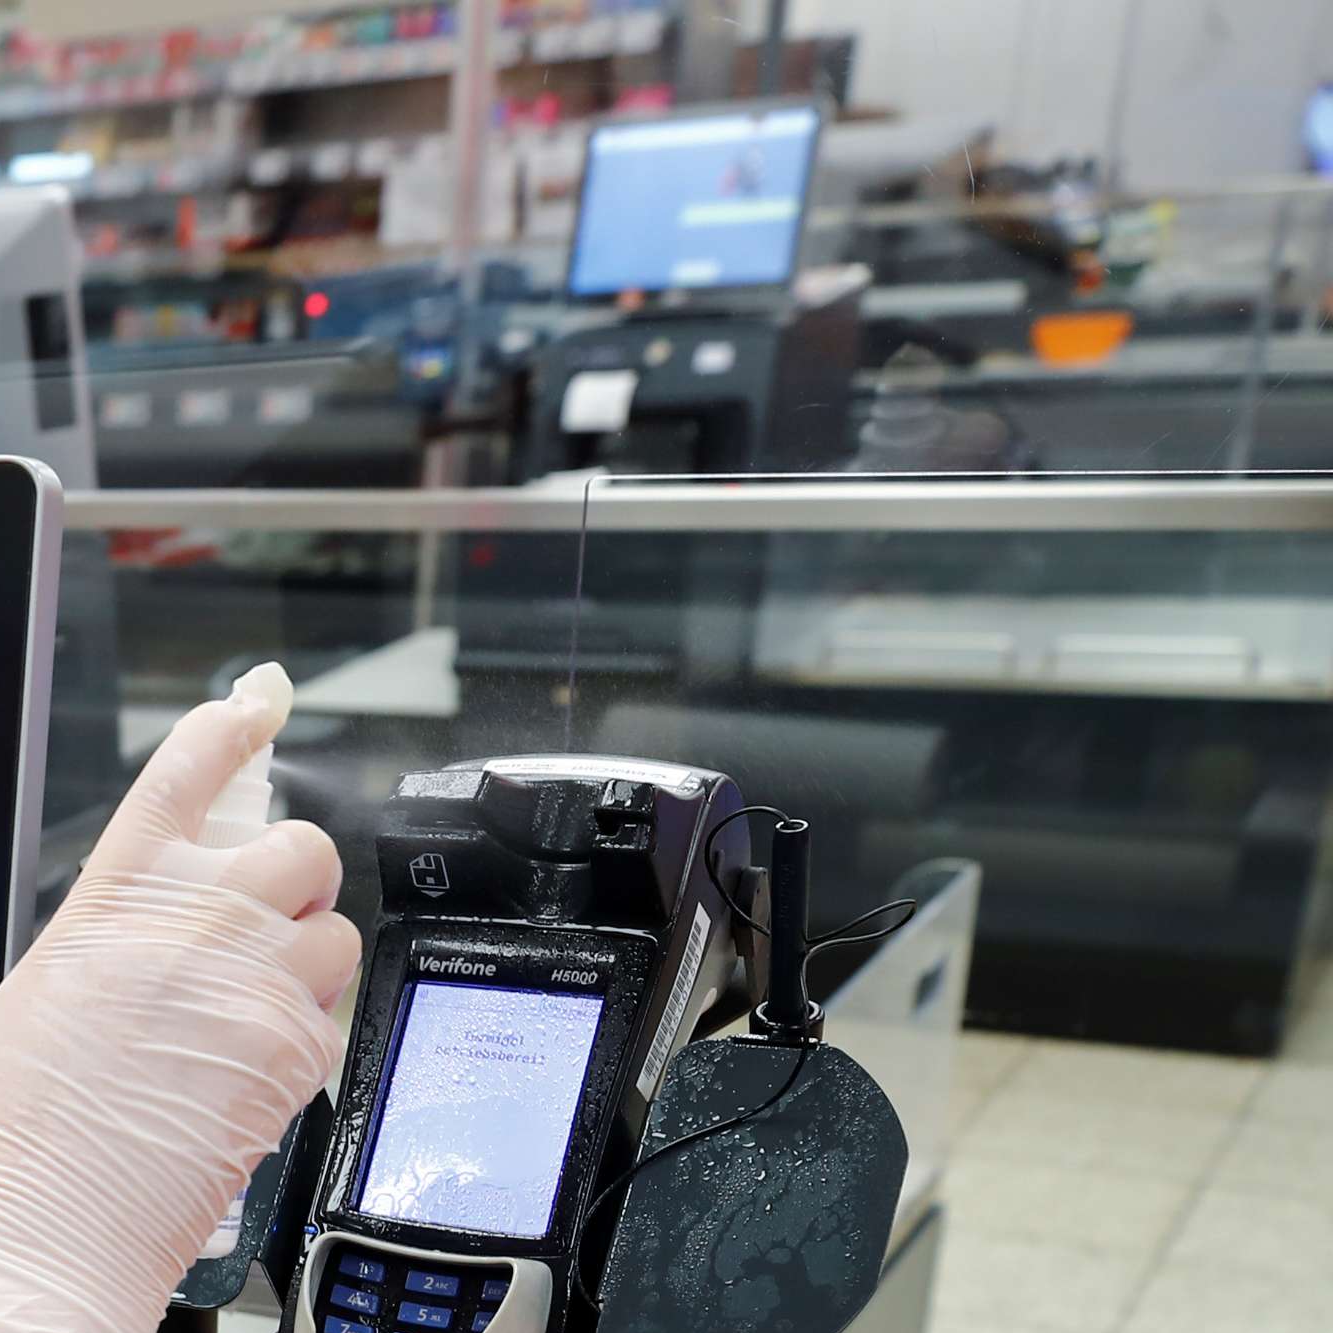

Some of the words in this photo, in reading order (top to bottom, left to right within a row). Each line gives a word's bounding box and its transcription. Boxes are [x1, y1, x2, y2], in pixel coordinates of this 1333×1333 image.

[418, 955, 497, 977] Verifone
[551, 969, 599, 985] H5000
[423, 1276, 434, 1290] 2
[417, 1308, 428, 1322] 5
